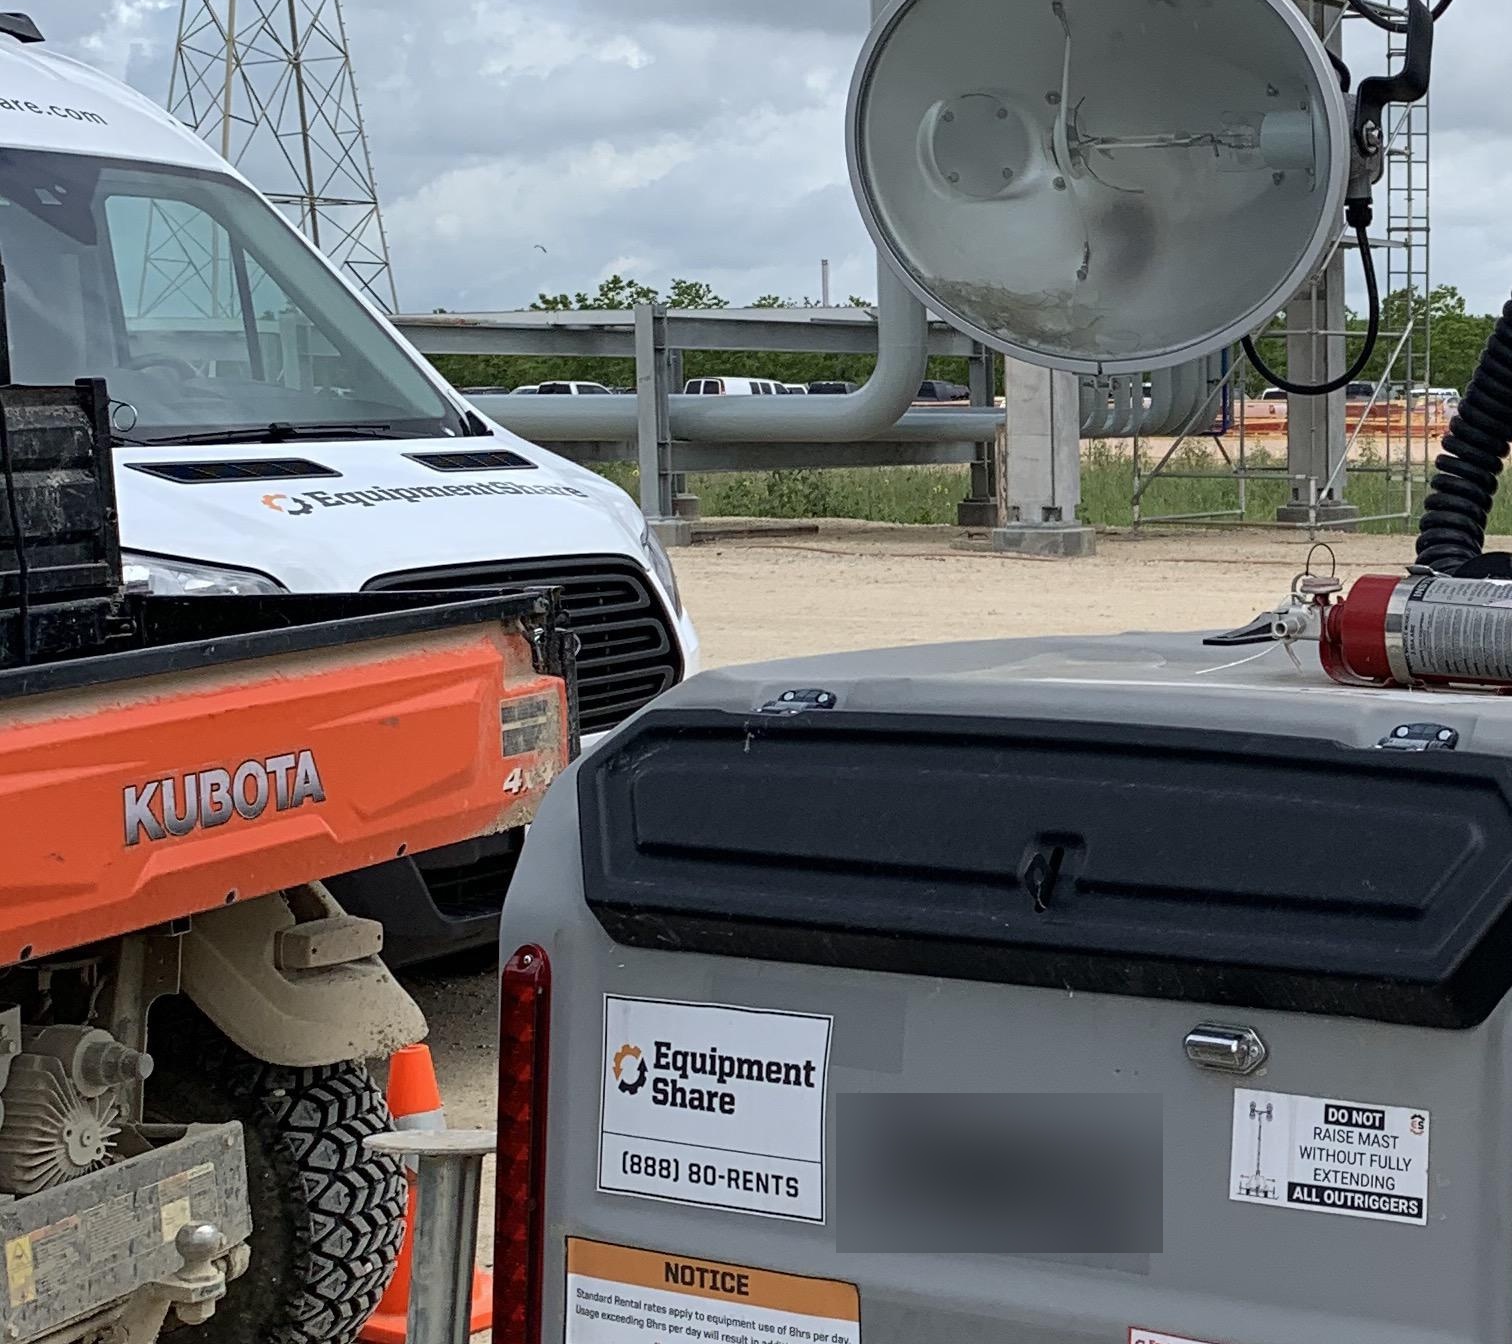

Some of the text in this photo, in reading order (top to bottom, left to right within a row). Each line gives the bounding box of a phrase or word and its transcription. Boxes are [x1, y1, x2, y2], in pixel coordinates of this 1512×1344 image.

[302, 481, 588, 507] EquipmentShare
[122, 750, 326, 847] KUBOTA
[653, 1041, 817, 1088] Equipment
[652, 1078, 736, 1115] Share
[1328, 1108, 1383, 1127] DO NOT
[1313, 1127, 1399, 1150] RAISE MAST
[622, 1151, 800, 1198] (888) 80-RENTS
[1300, 1145, 1412, 1172] WITHOUT FULLY
[1313, 1167, 1395, 1190] EXTENDING
[1292, 1186, 1419, 1214] ALL OUTRIGGERS
[664, 1261, 749, 1296] NOTICE
[576, 1288, 612, 1304] Standard
[614, 1296, 642, 1309] Rental
[644, 1303, 666, 1314] rates
[669, 1307, 693, 1321] apply
[695, 1311, 705, 1321] to
[707, 1315, 755, 1330] equipment
[758, 1324, 774, 1334] use
[777, 1326, 787, 1335] of
[790, 1326, 811, 1340] 8hrs
[813, 1332, 829, 1343] per
[576, 1304, 599, 1319] Usage
[601, 1311, 644, 1329] exceeding
[668, 1323, 684, 1334] per
[685, 1325, 702, 1339] day
[703, 1330, 719, 1341] will
